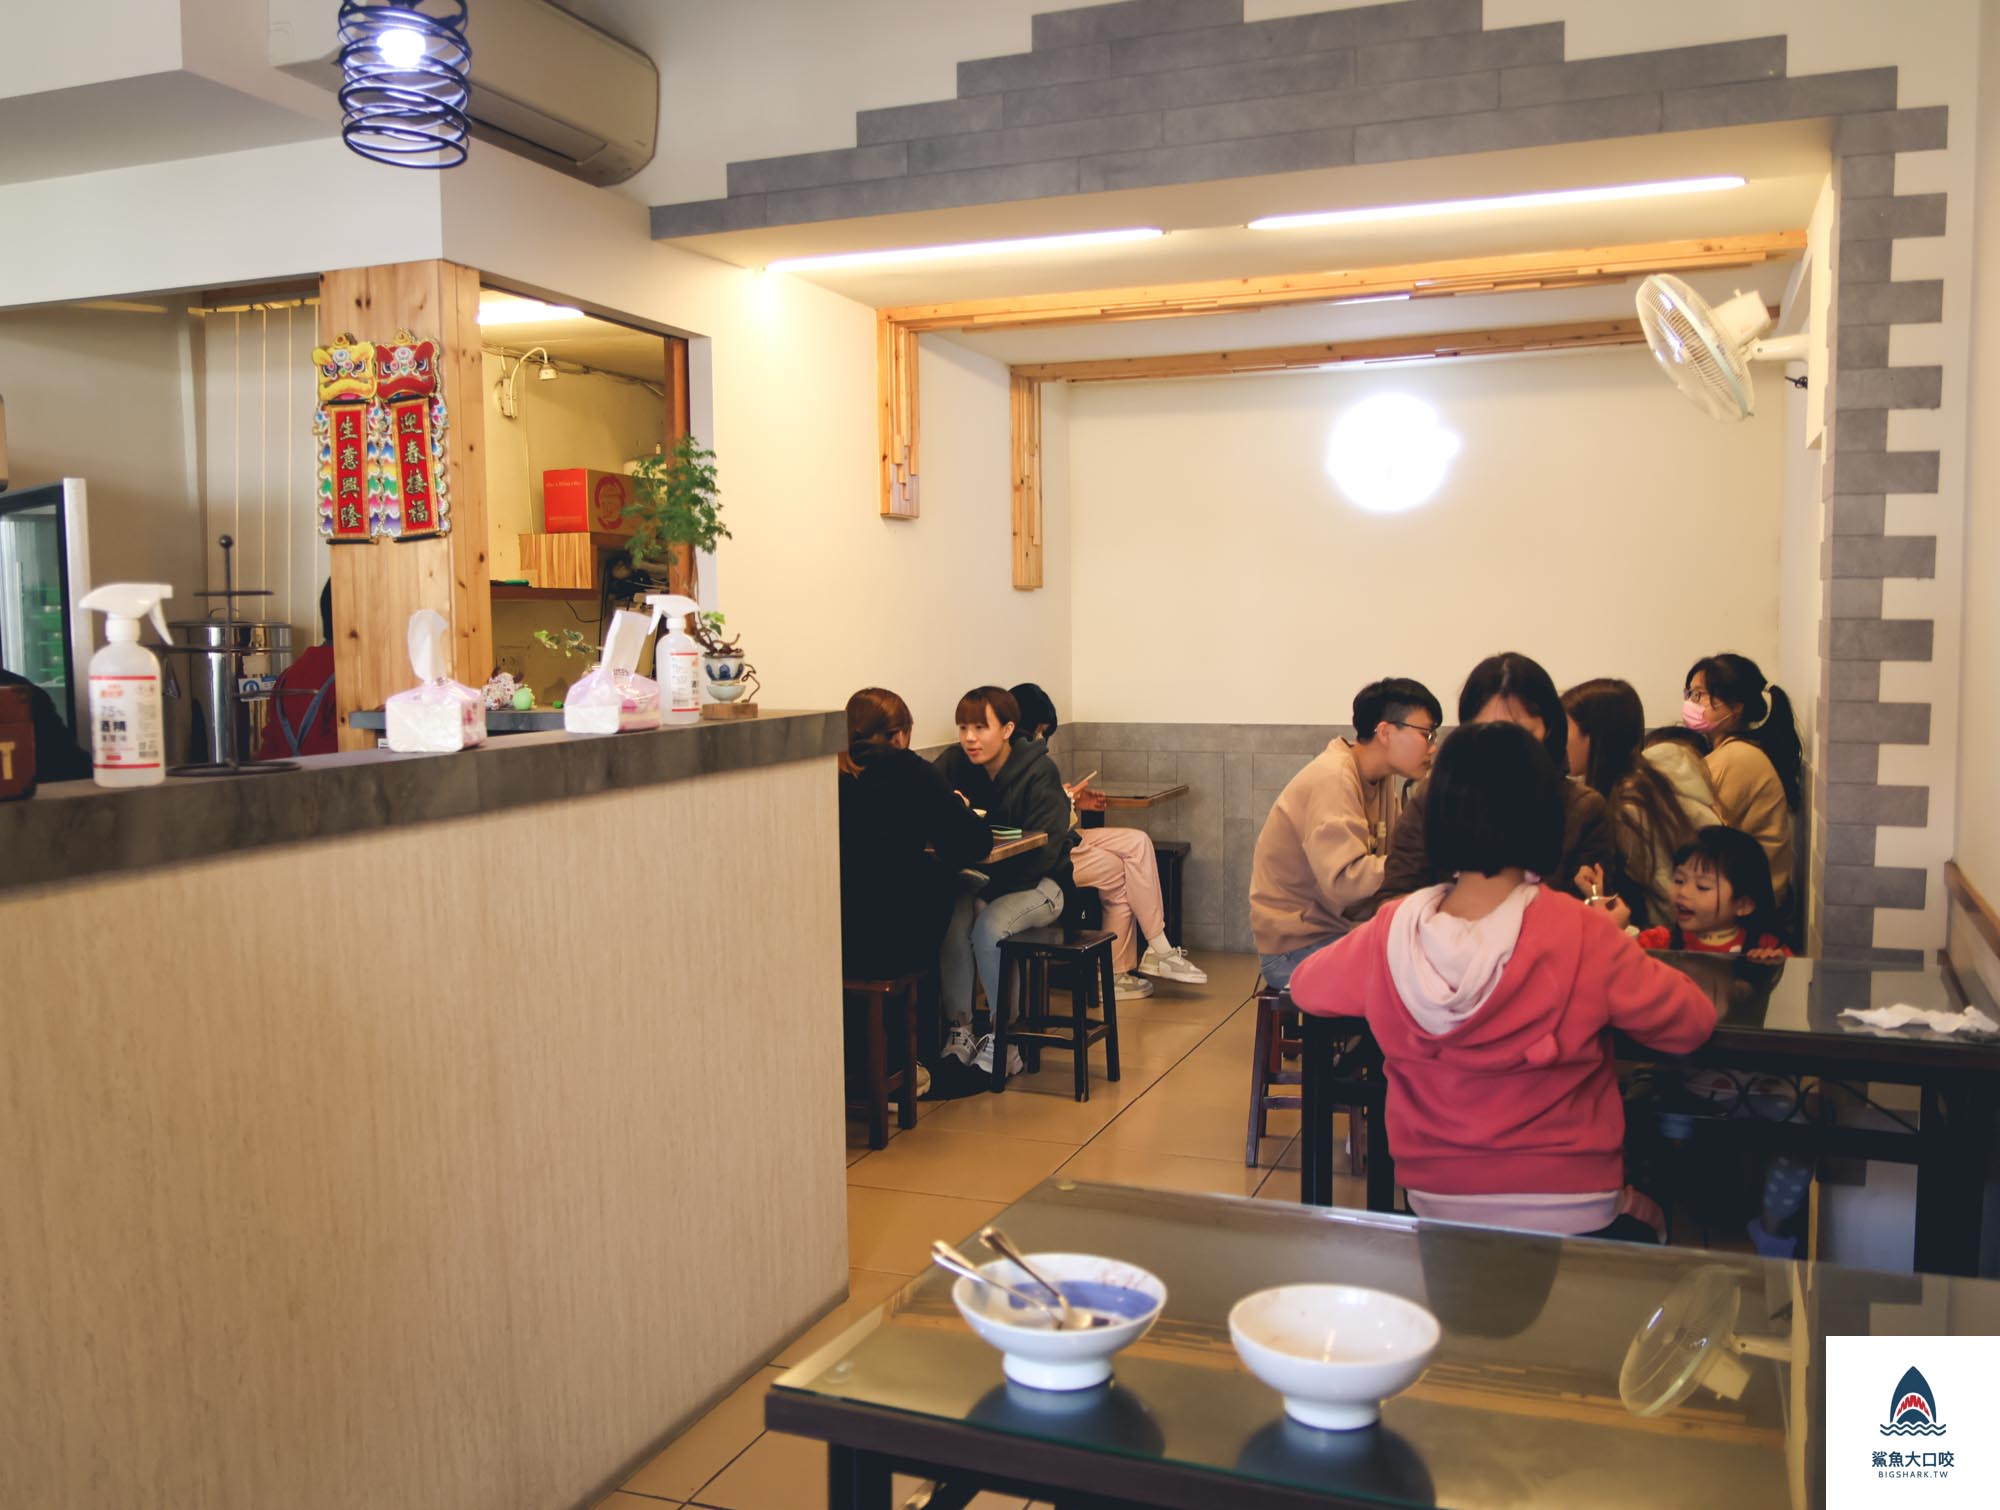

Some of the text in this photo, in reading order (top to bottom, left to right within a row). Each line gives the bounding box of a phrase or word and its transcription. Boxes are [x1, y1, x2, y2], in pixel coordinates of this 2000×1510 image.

[340, 416, 362, 528] 生意興隆
[401, 412, 428, 523] 迎春接福
